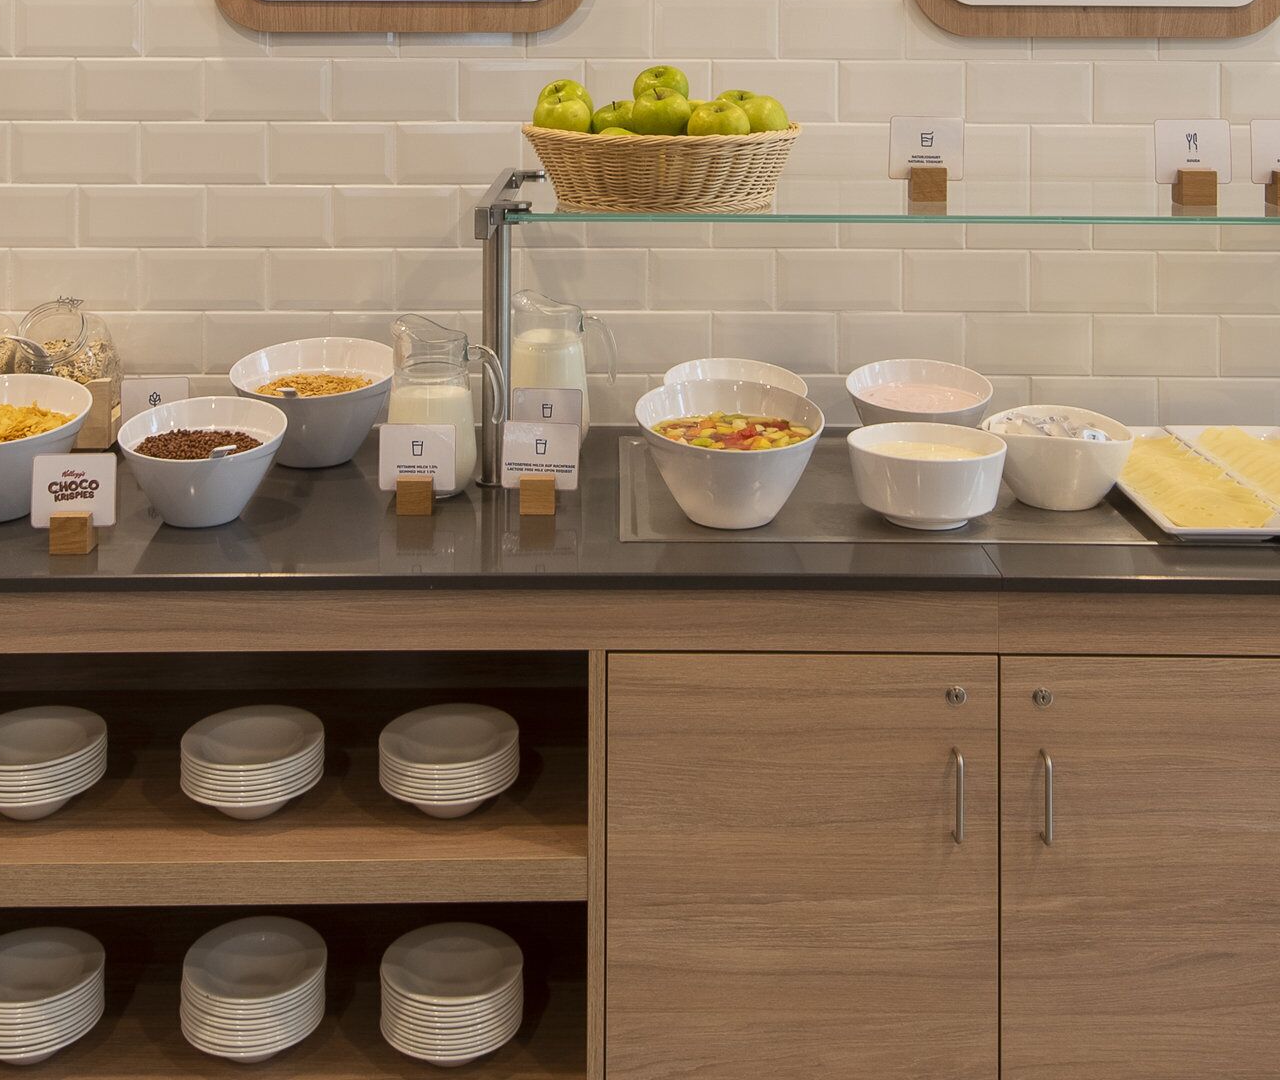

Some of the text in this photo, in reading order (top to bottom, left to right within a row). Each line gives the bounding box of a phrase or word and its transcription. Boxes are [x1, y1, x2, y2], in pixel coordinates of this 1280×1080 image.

[62, 470, 85, 478] Kellogg's
[48, 479, 99, 494] CHOCO
[54, 491, 94, 502] KRISPIES
